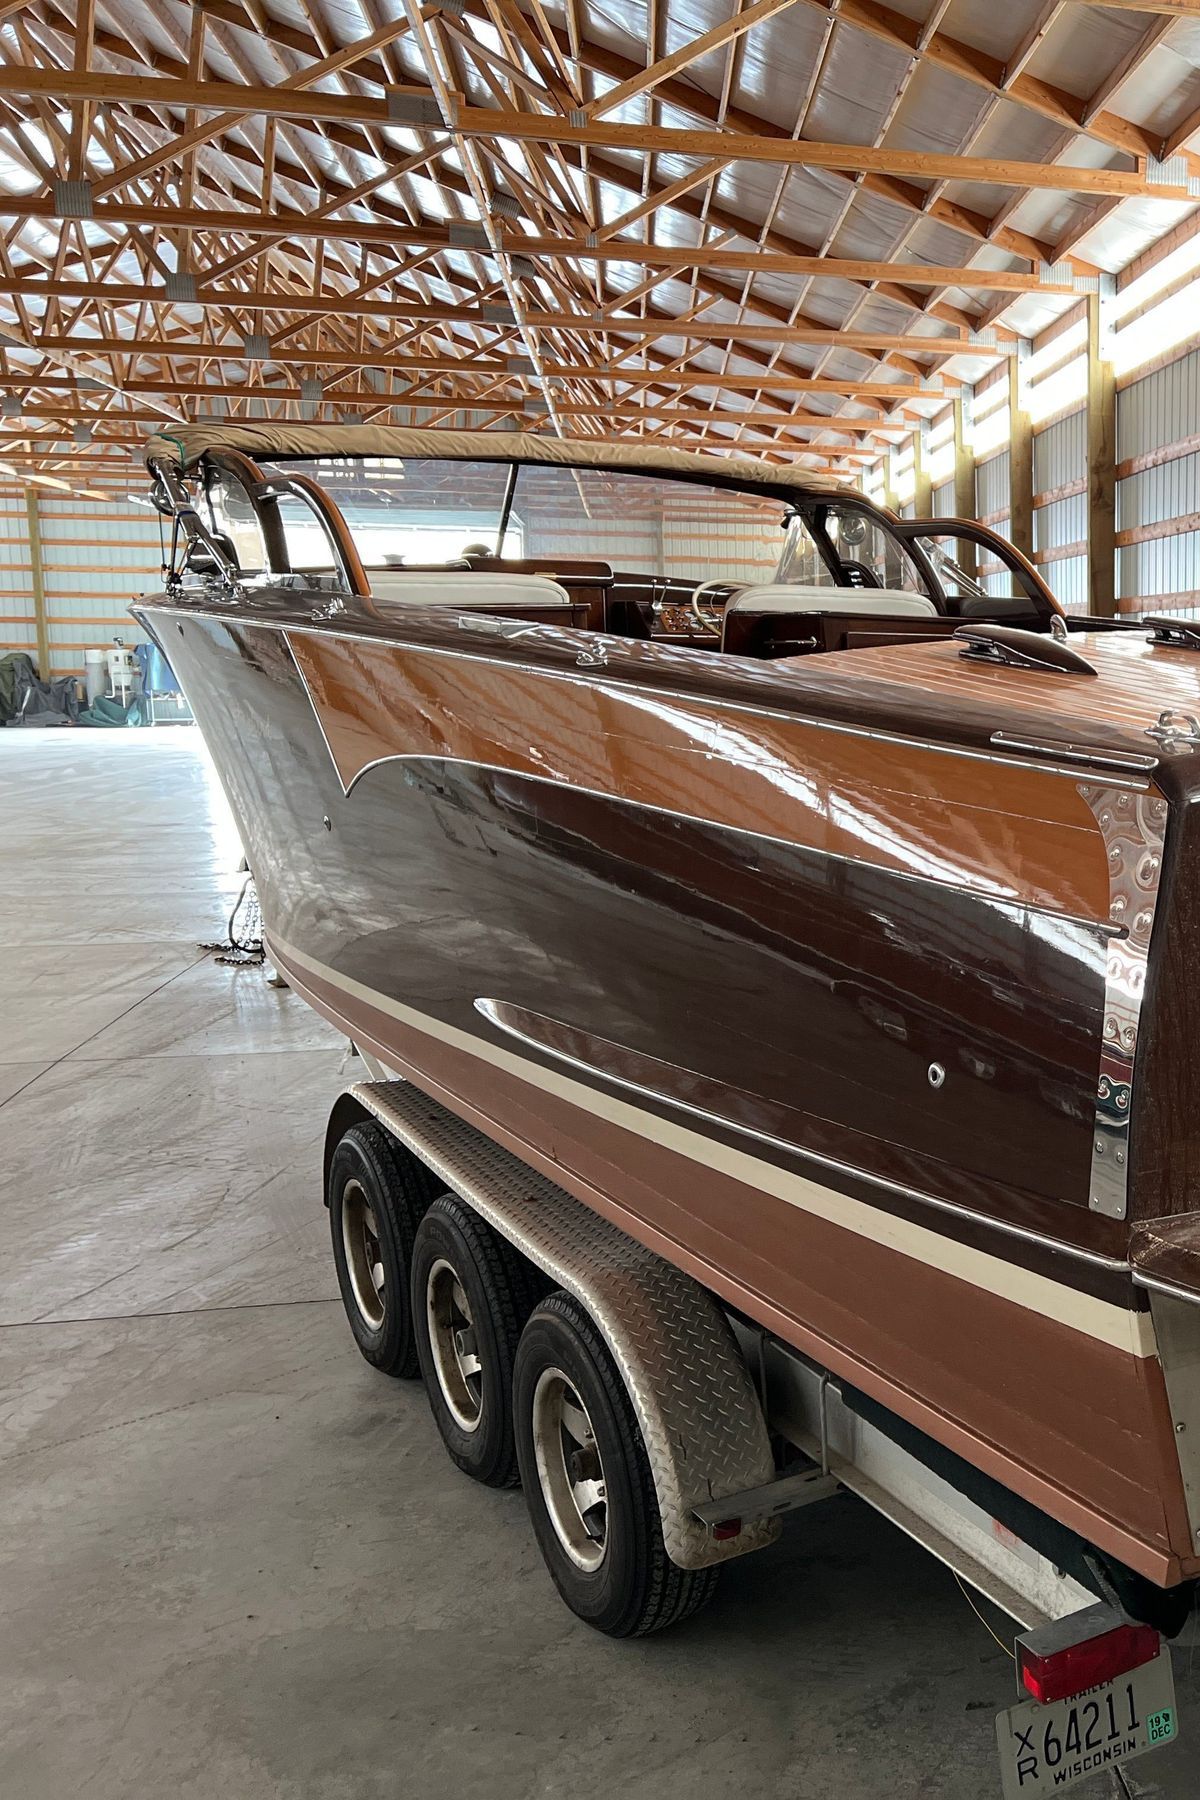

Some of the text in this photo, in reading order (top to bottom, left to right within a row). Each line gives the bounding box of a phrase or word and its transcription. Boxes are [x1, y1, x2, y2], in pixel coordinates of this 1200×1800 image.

[1044, 1683, 1140, 1766] 64211
[1149, 1716, 1160, 1728] 19
[1151, 1726, 1171, 1741] DEC
[1014, 1725, 1035, 1757] X
[1017, 1756, 1039, 1786] R
[1054, 1737, 1137, 1785] WISCONSIN
